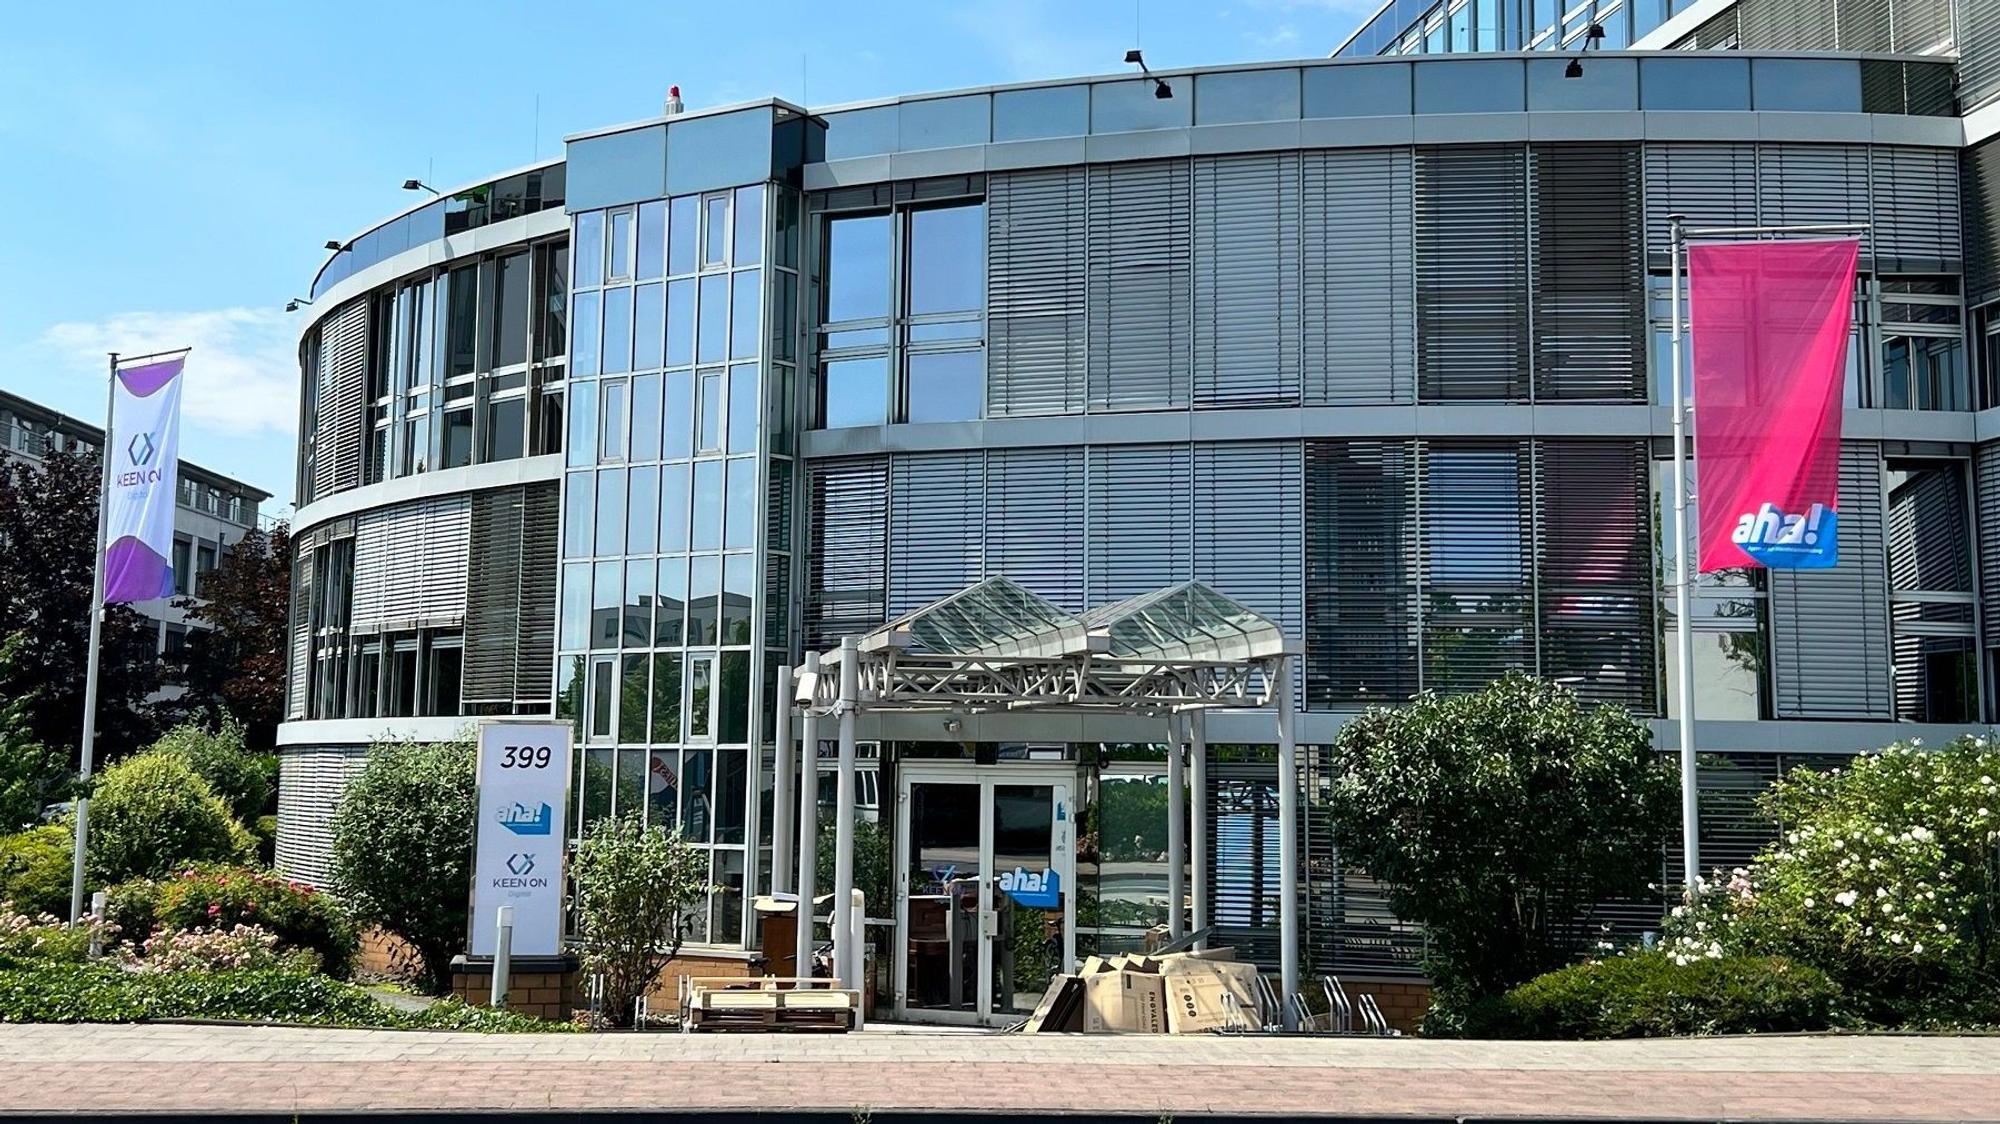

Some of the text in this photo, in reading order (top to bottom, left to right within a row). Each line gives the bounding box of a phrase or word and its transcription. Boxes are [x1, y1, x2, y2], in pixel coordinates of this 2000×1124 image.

[117, 471, 145, 487] KEEN
[1732, 502, 1823, 545] aha!
[500, 746, 551, 769] 399
[496, 801, 543, 823] aha!
[493, 878, 547, 888] KEEN ON
[999, 866, 1050, 892] aha!
